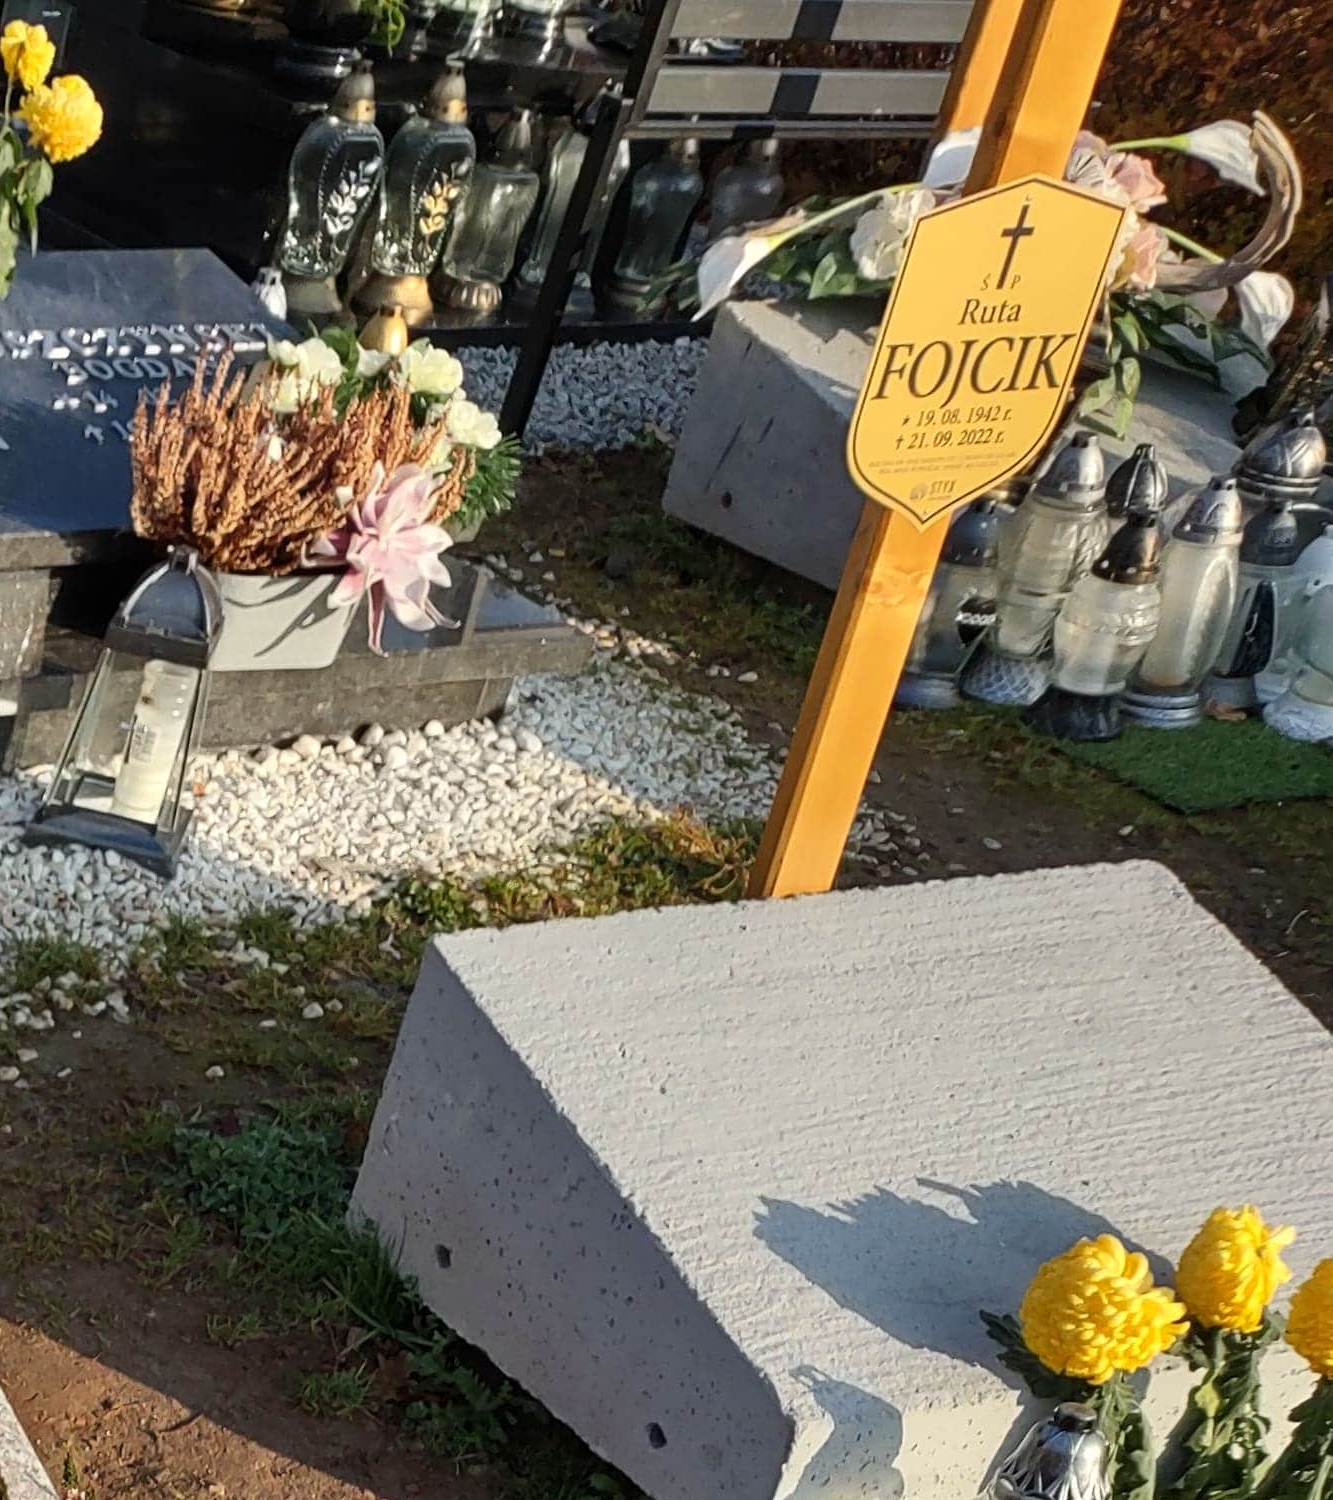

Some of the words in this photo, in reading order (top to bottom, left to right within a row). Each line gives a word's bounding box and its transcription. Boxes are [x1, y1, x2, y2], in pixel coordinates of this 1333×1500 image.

[957, 298, 1021, 325] Ruta
[870, 333, 1077, 409] FOJCIK
[965, 405, 1002, 424] 1942
[956, 427, 994, 446] 2022
